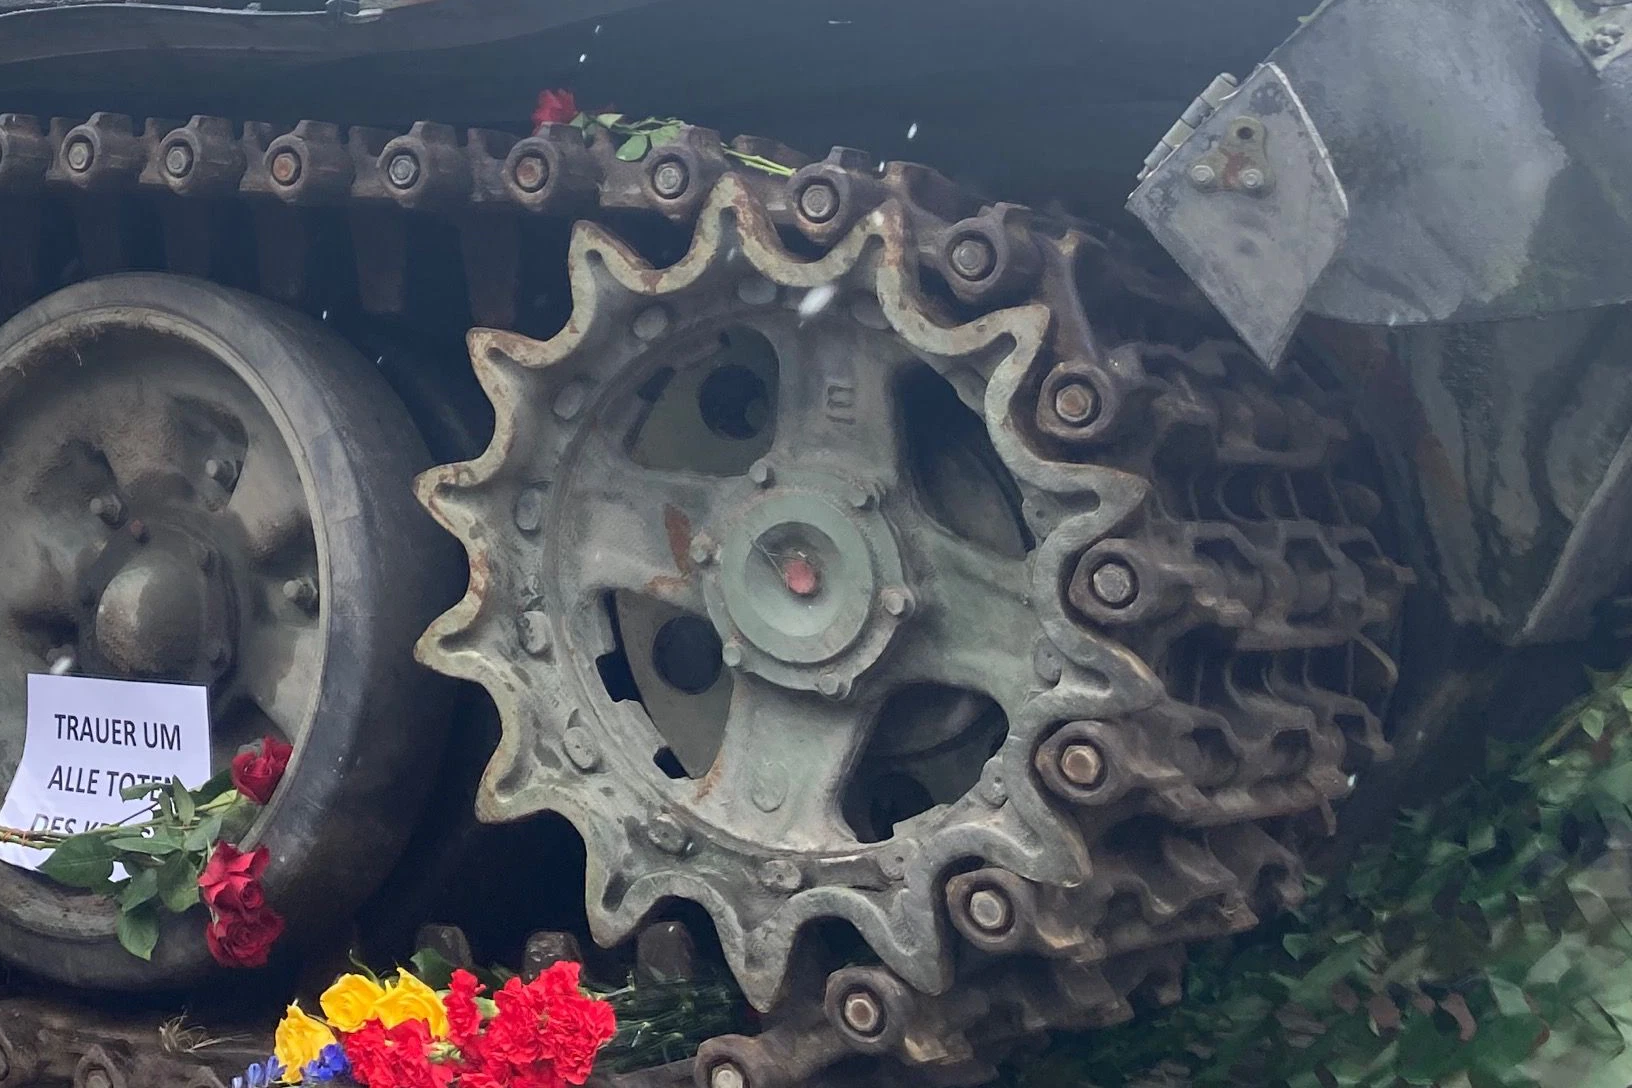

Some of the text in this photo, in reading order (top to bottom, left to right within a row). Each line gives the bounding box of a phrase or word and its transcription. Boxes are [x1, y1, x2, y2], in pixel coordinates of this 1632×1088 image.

[54, 714, 181, 751] TRAUER UM
[48, 765, 99, 795] ALLE
